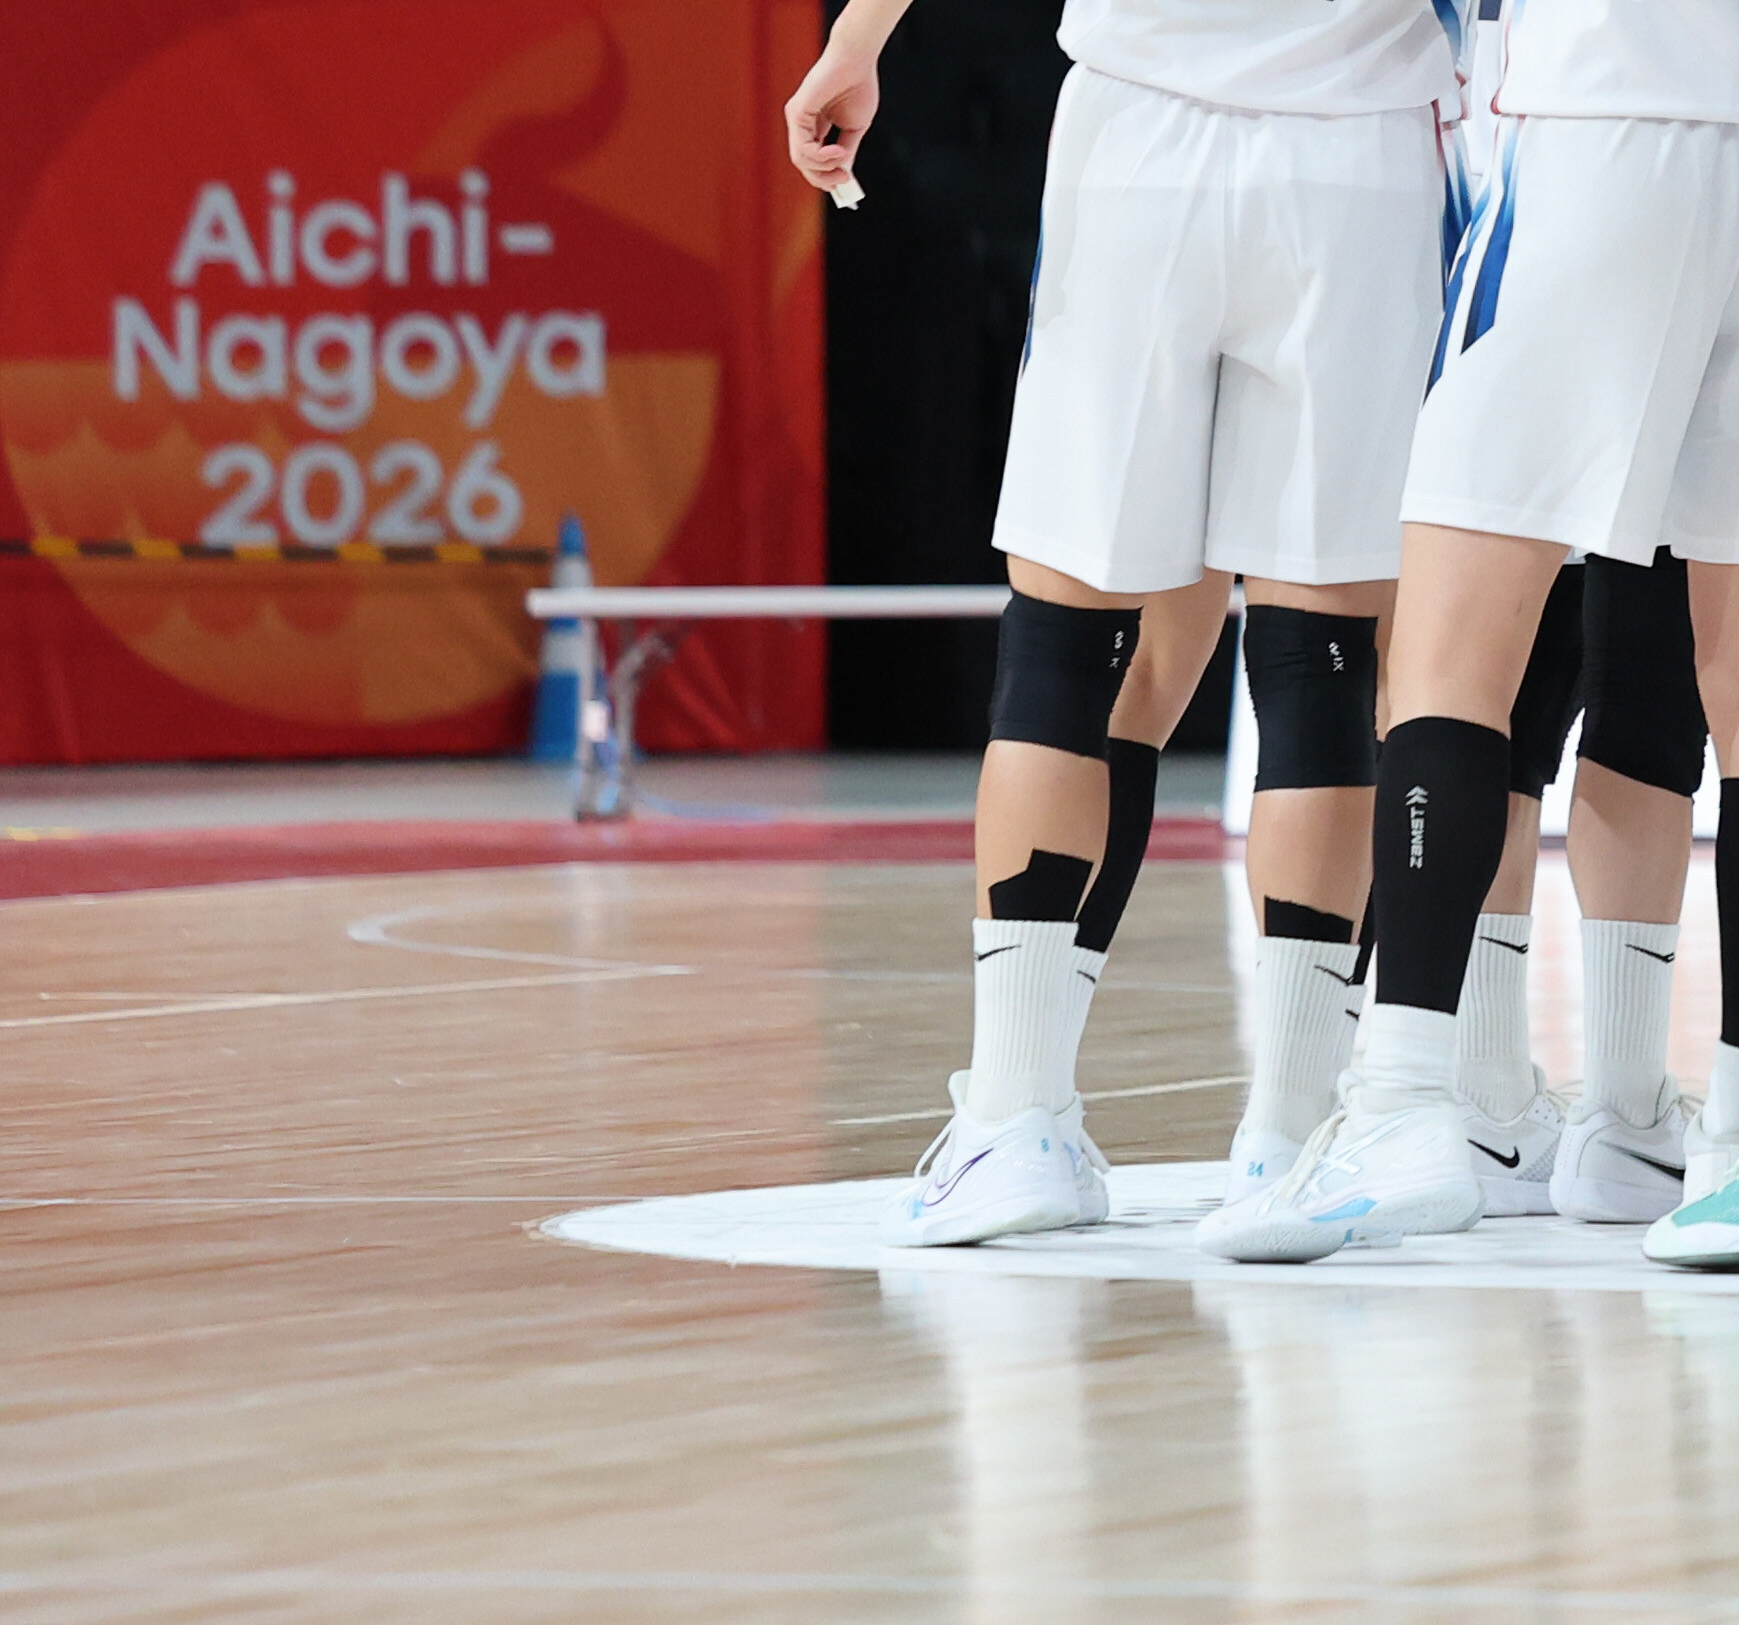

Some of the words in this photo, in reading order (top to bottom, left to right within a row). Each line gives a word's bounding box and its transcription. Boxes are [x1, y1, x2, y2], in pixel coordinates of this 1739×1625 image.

[171, 170, 553, 285] Aichi-
[113, 298, 607, 430] Nagoya
[200, 442, 523, 546] 2026
